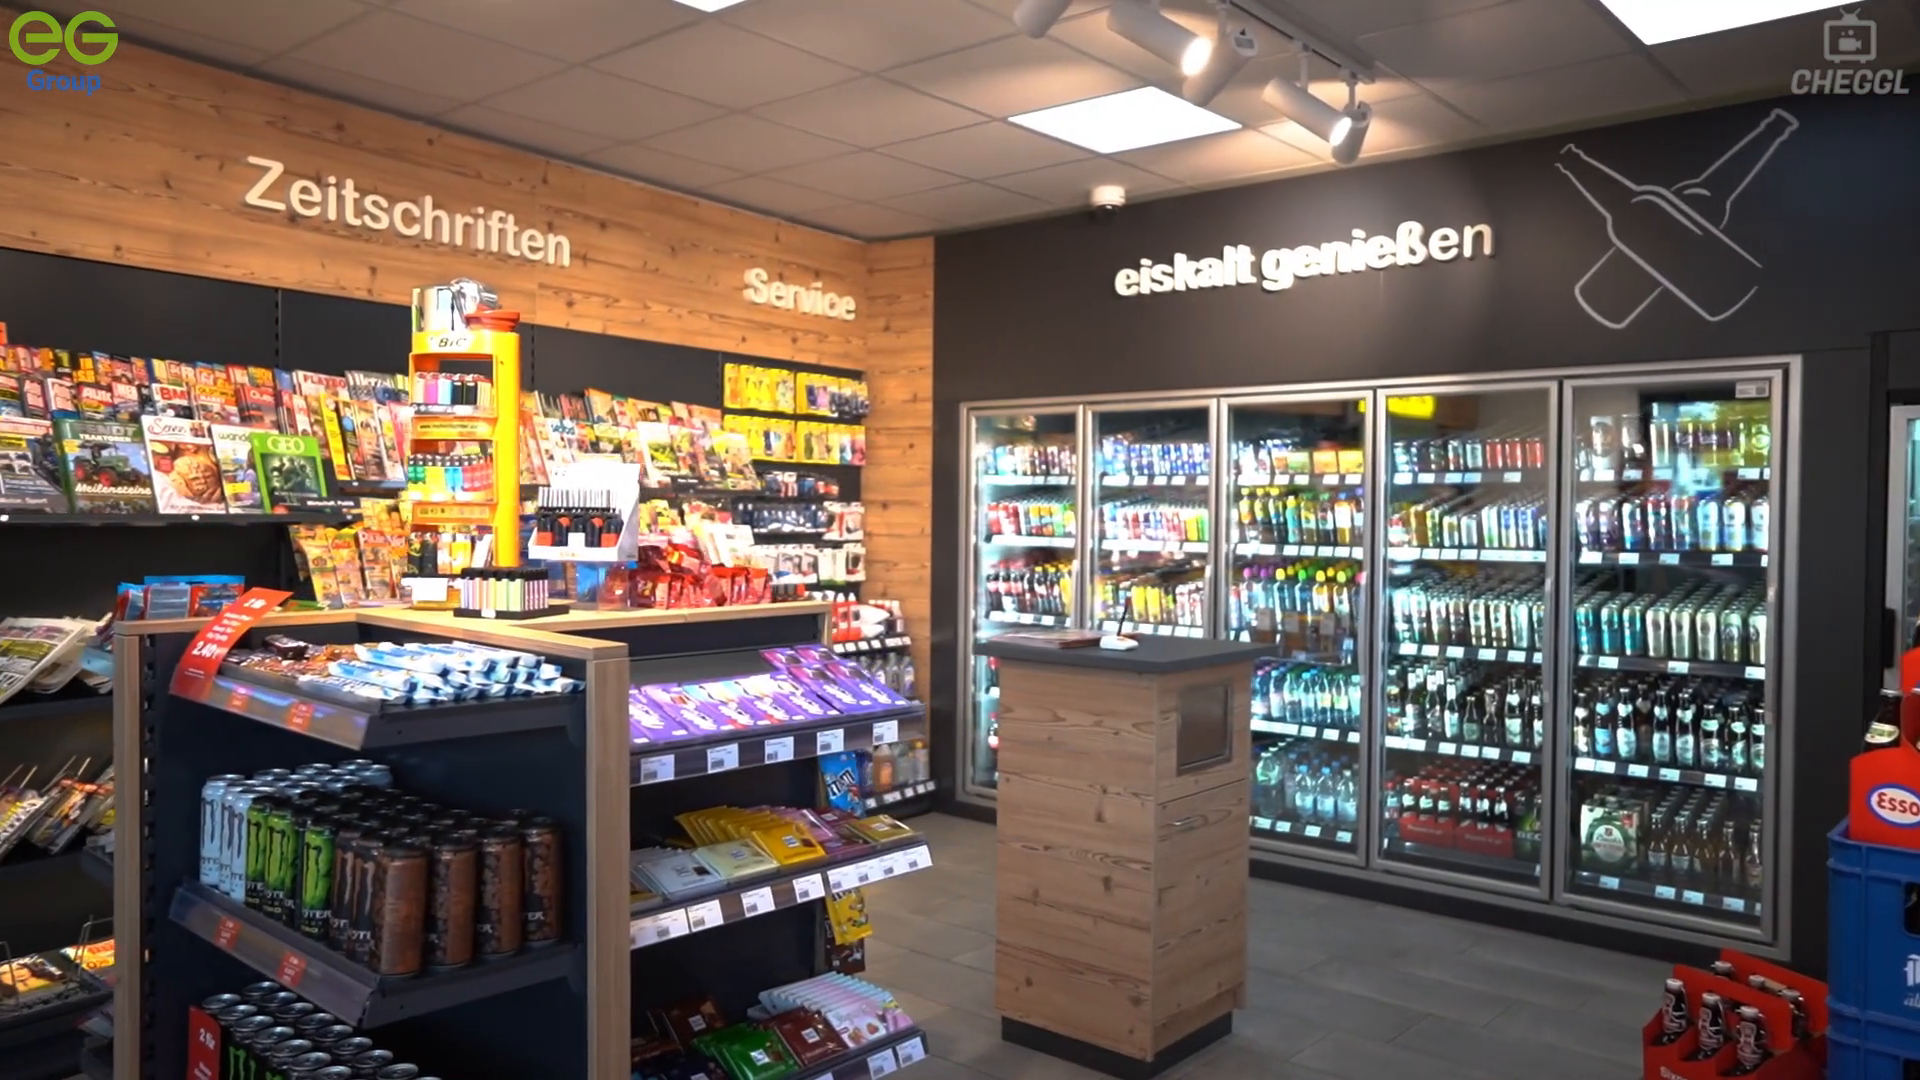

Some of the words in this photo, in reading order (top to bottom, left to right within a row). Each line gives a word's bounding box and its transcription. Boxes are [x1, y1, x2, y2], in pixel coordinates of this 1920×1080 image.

[244, 155, 572, 268] Zeitschriften
[1114, 243, 1257, 297] eiskalt
[1260, 219, 1494, 292] genießen
[743, 267, 857, 322] Service
[266, 436, 306, 455] GEO
